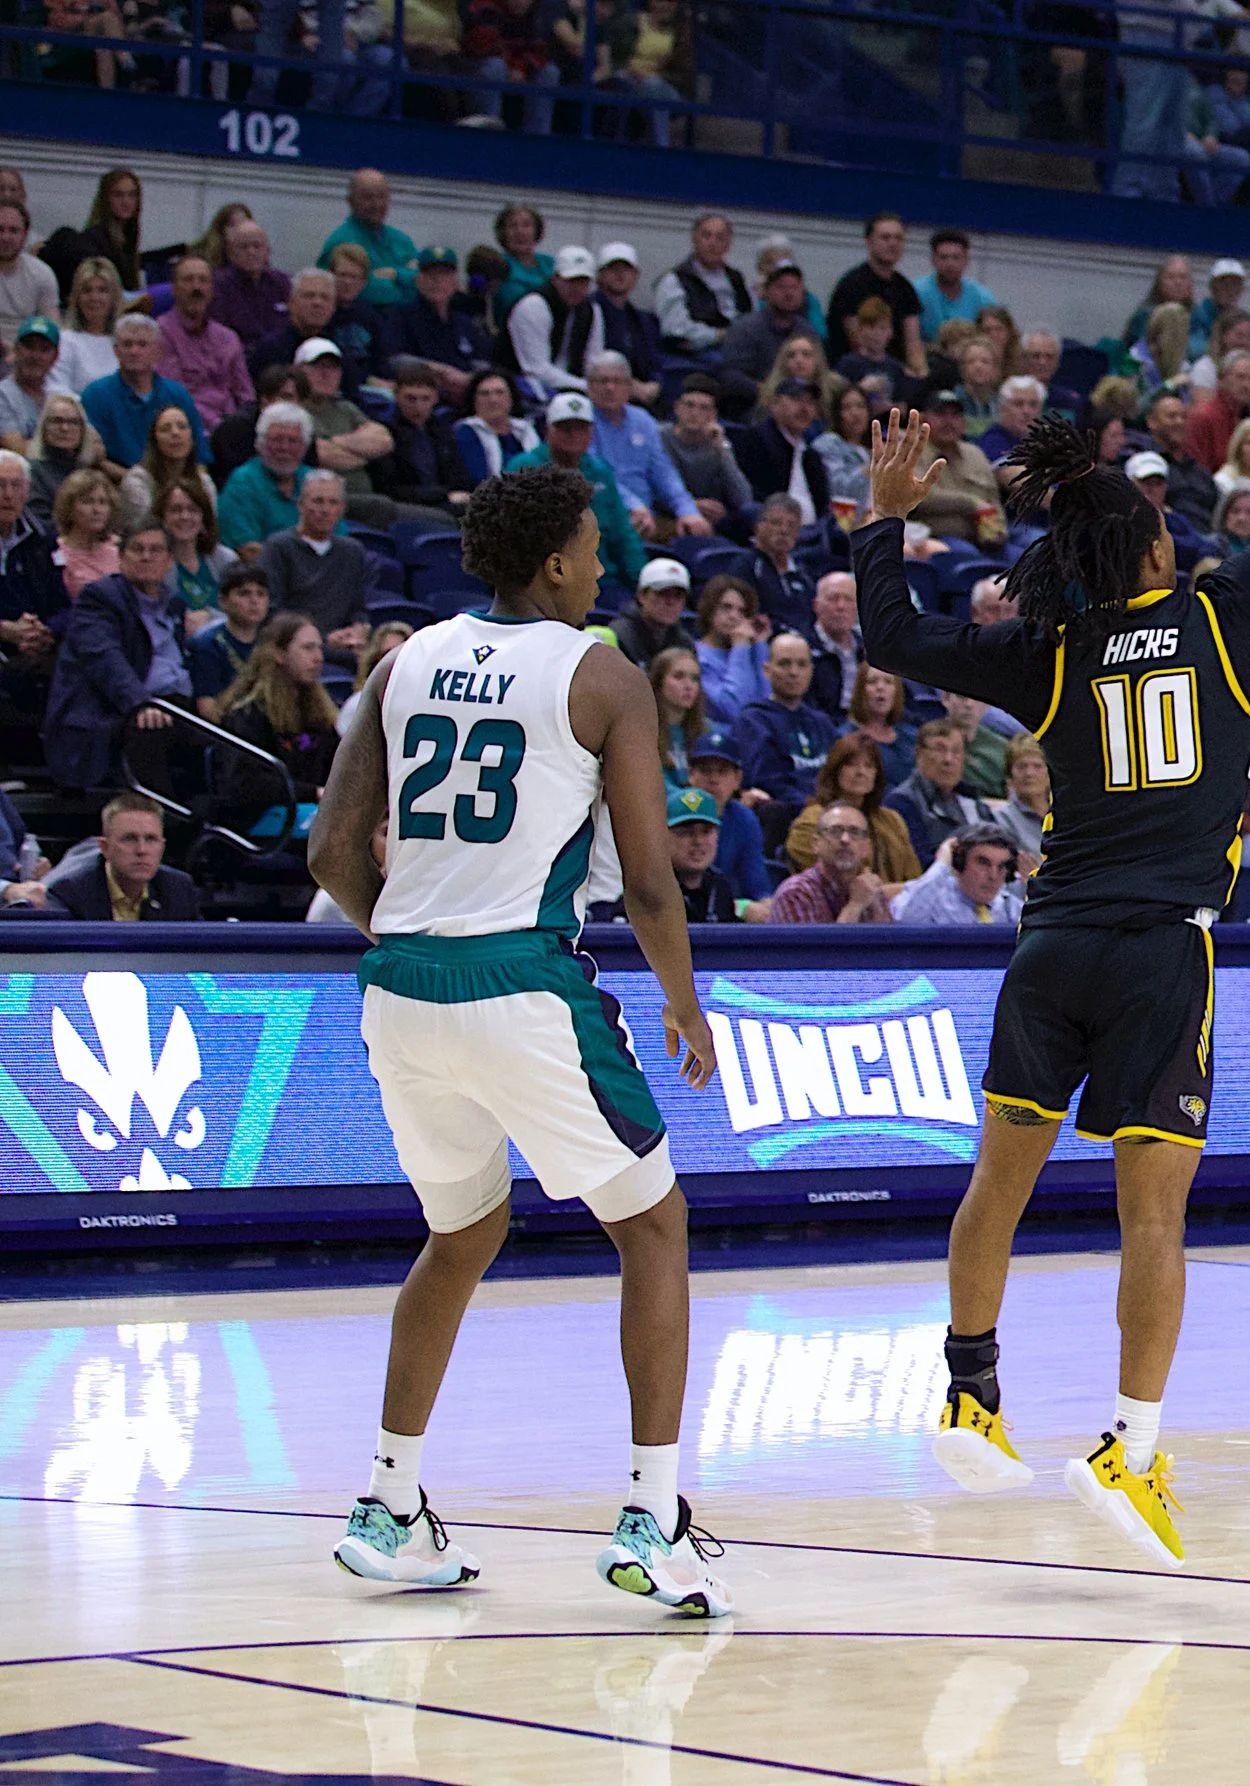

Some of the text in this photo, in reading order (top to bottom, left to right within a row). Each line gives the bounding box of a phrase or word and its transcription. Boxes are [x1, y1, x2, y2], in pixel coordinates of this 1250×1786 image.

[218, 109, 301, 158] 102
[1102, 628, 1179, 666] HICKS
[429, 668, 516, 704] KELLY
[1090, 666, 1203, 792] 10
[398, 713, 526, 844] 23
[706, 1008, 979, 1132] UNCW
[79, 1214, 177, 1229] DAKTRONICS
